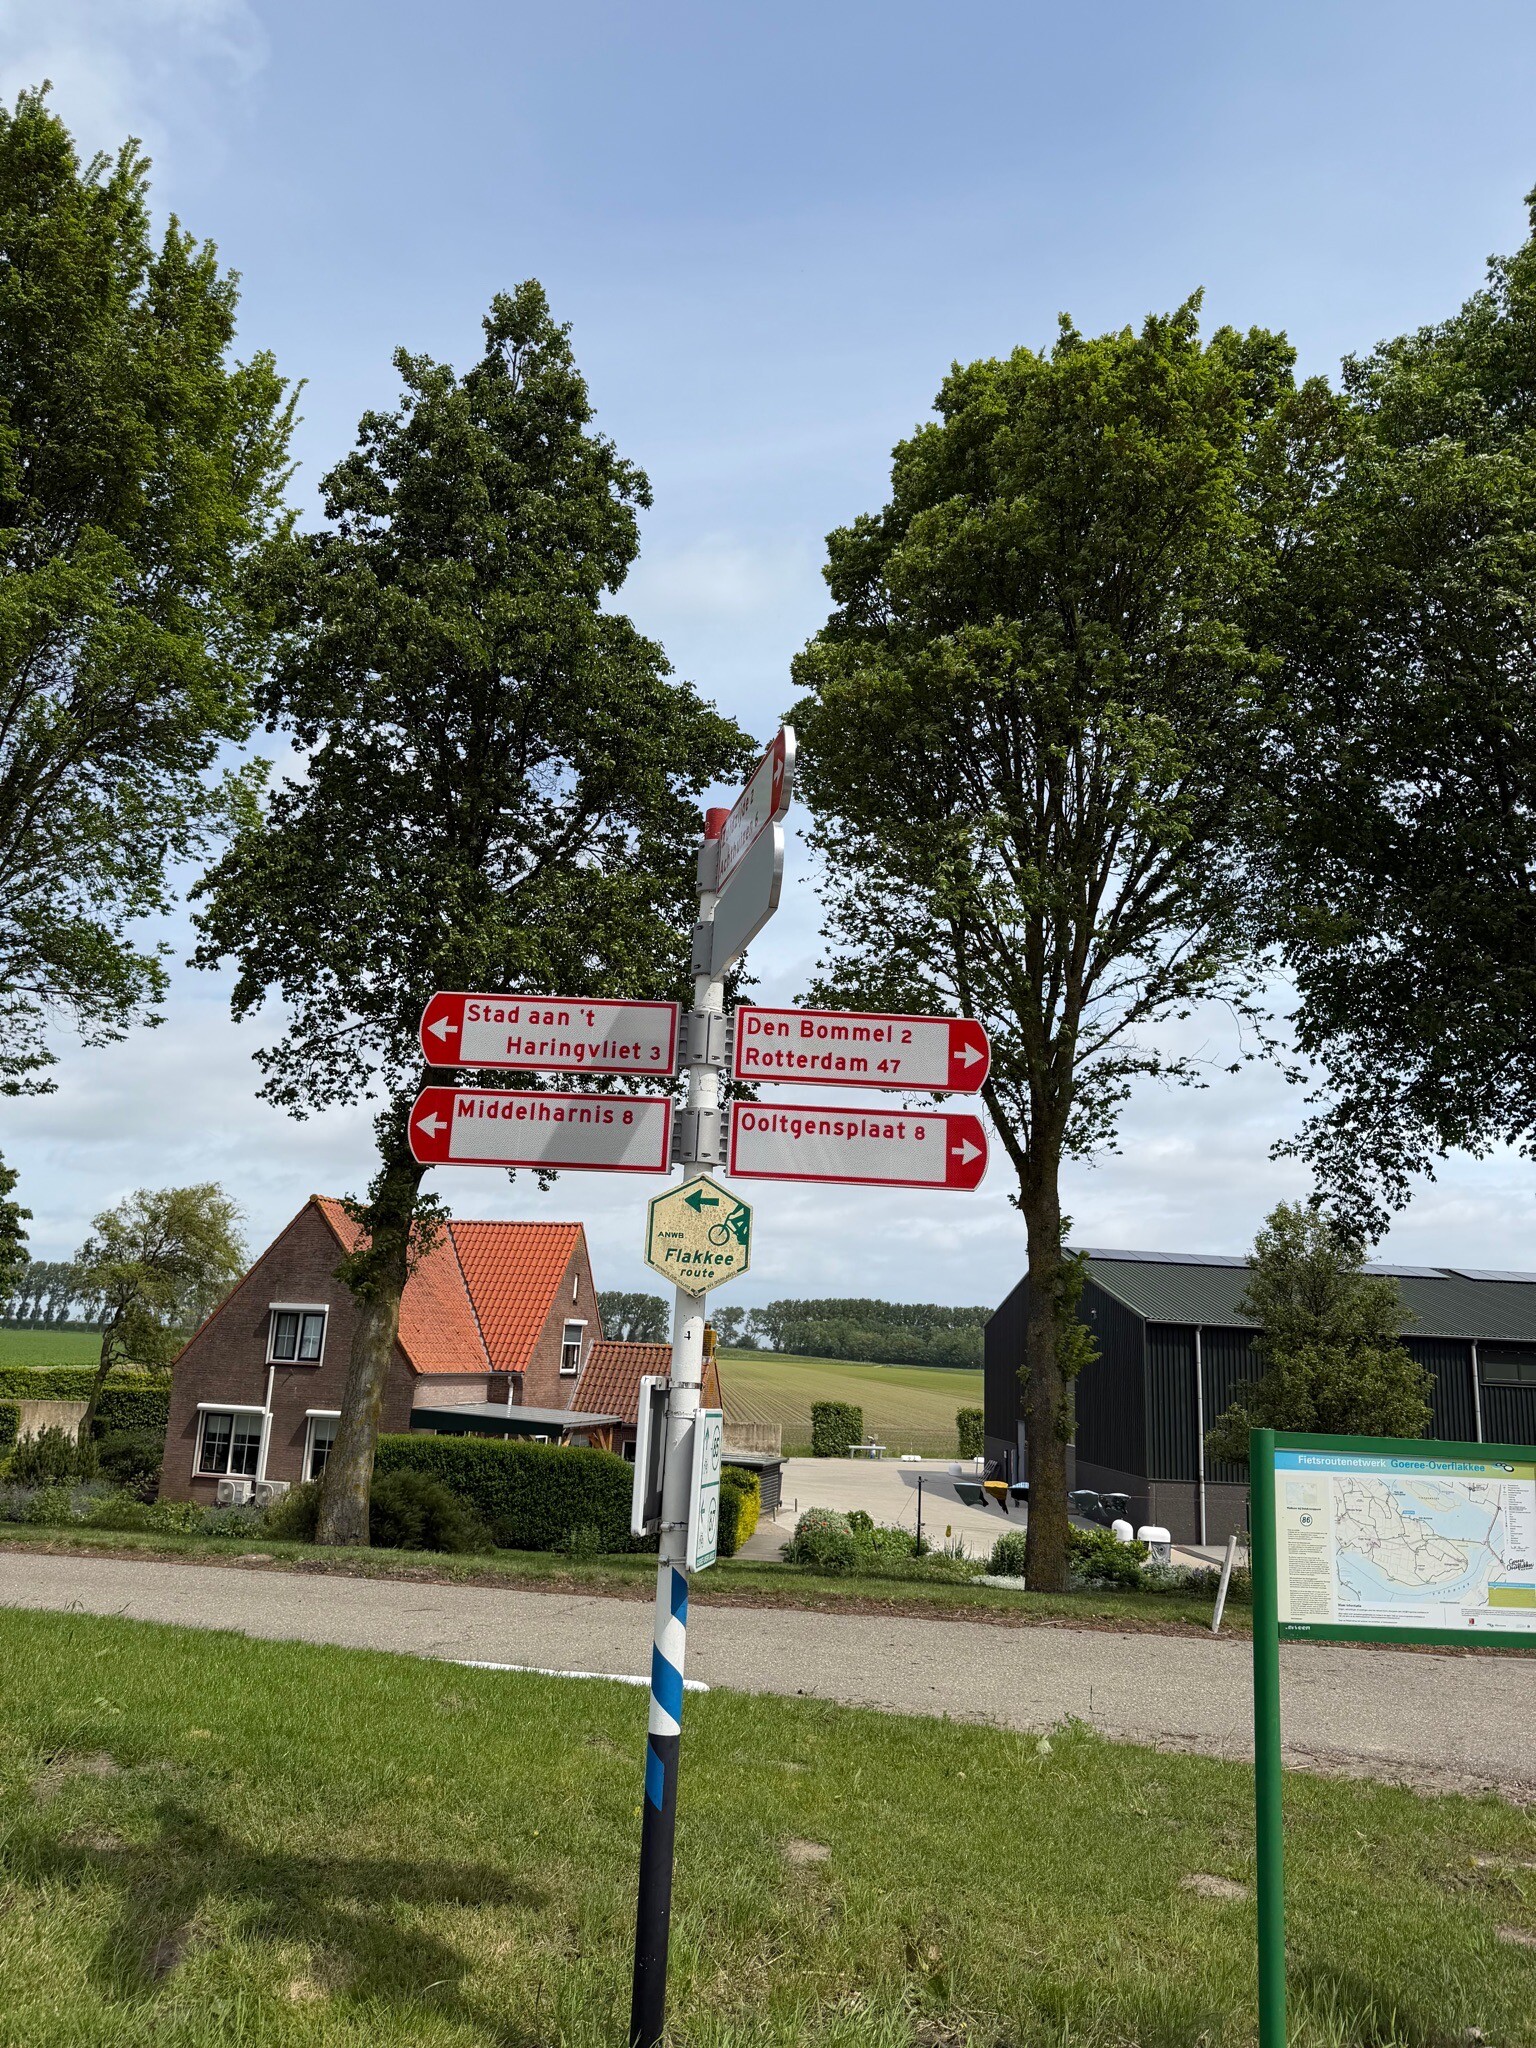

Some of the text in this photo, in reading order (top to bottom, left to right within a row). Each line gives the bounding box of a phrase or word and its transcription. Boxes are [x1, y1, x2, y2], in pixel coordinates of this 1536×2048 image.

[467, 1004, 595, 1027] Stad aan 't
[747, 1016, 912, 1044] Den Bommel 2
[506, 1036, 661, 1062] Haringvliet 3
[745, 1047, 901, 1074] Rotterdam 47
[457, 1099, 634, 1125] Middelharnis 8
[741, 1112, 925, 1140] Ooltgensplaat 8
[658, 1231, 684, 1239] ANWB
[665, 1248, 734, 1266] Flakkee
[680, 1268, 715, 1278] route
[1298, 1455, 1486, 1472] Fietsroutenetwerk Goeree-Overflakkee
[1301, 1516, 1311, 1524] 86
